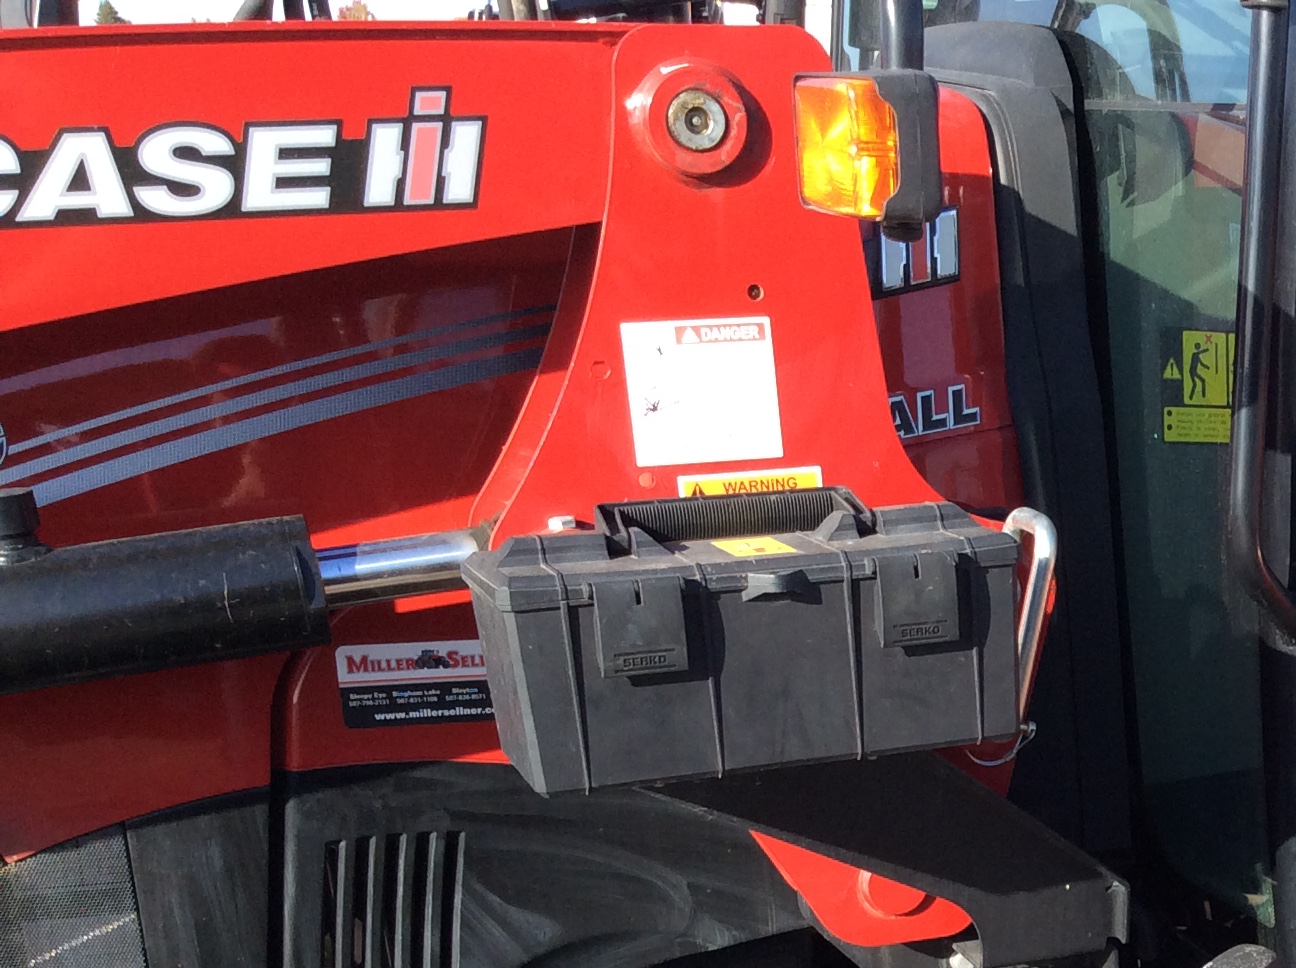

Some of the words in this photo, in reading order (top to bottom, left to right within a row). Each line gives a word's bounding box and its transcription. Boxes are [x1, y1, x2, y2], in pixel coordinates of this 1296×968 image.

[0, 122, 339, 223] ASE
[701, 325, 760, 341] DANGER
[722, 477, 798, 495] WARNING
[901, 625, 941, 639] SERKO
[623, 655, 667, 668] SERKO
